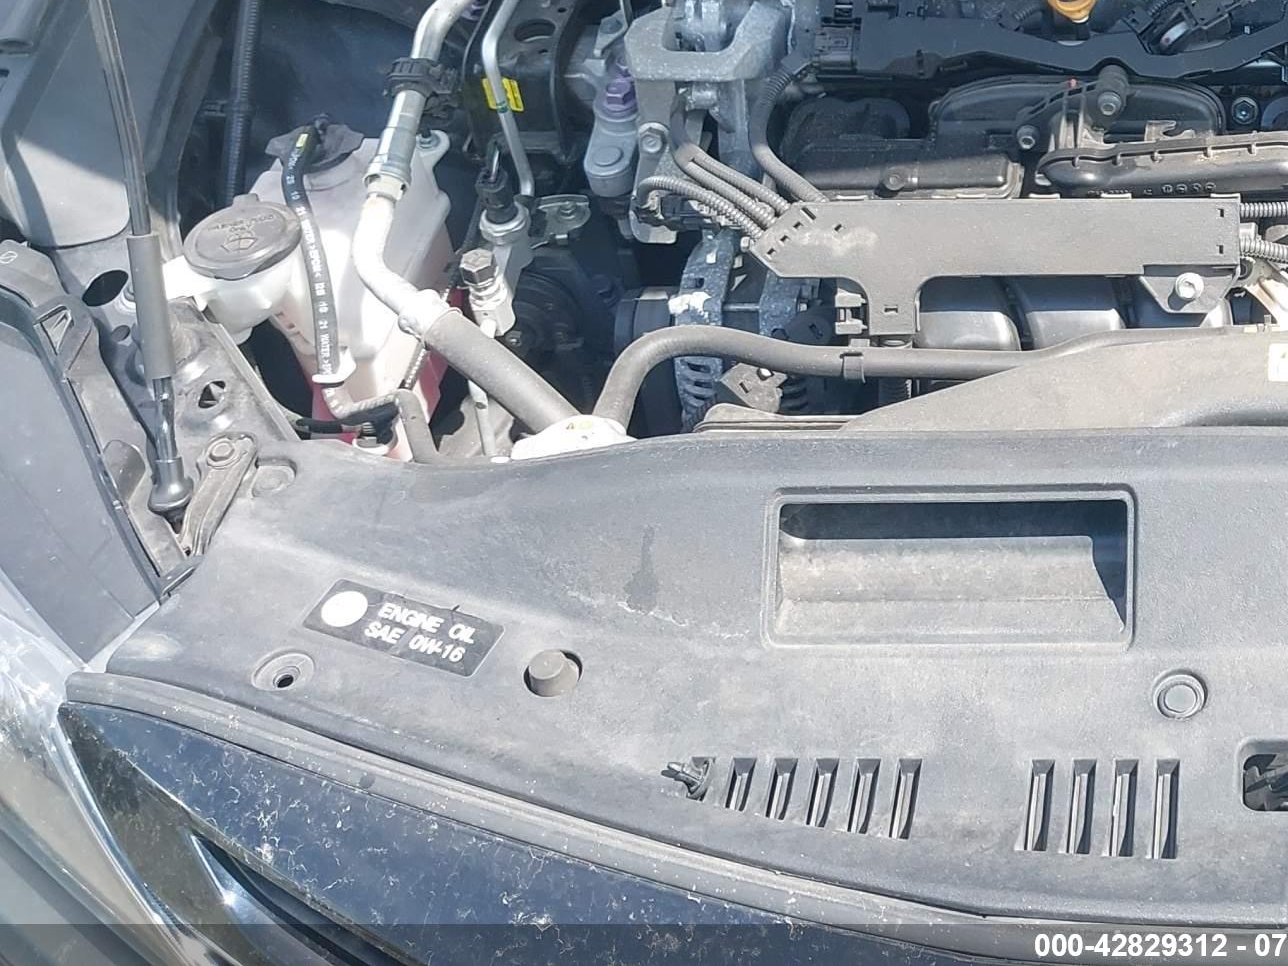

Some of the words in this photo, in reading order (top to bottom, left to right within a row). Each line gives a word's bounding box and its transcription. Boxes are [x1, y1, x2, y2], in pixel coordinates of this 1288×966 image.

[319, 333, 331, 358] WATER
[364, 622, 405, 644] SAE
[409, 634, 466, 663] 0W-16
[378, 602, 444, 633] ENGINE
[448, 623, 475, 644] OIL
